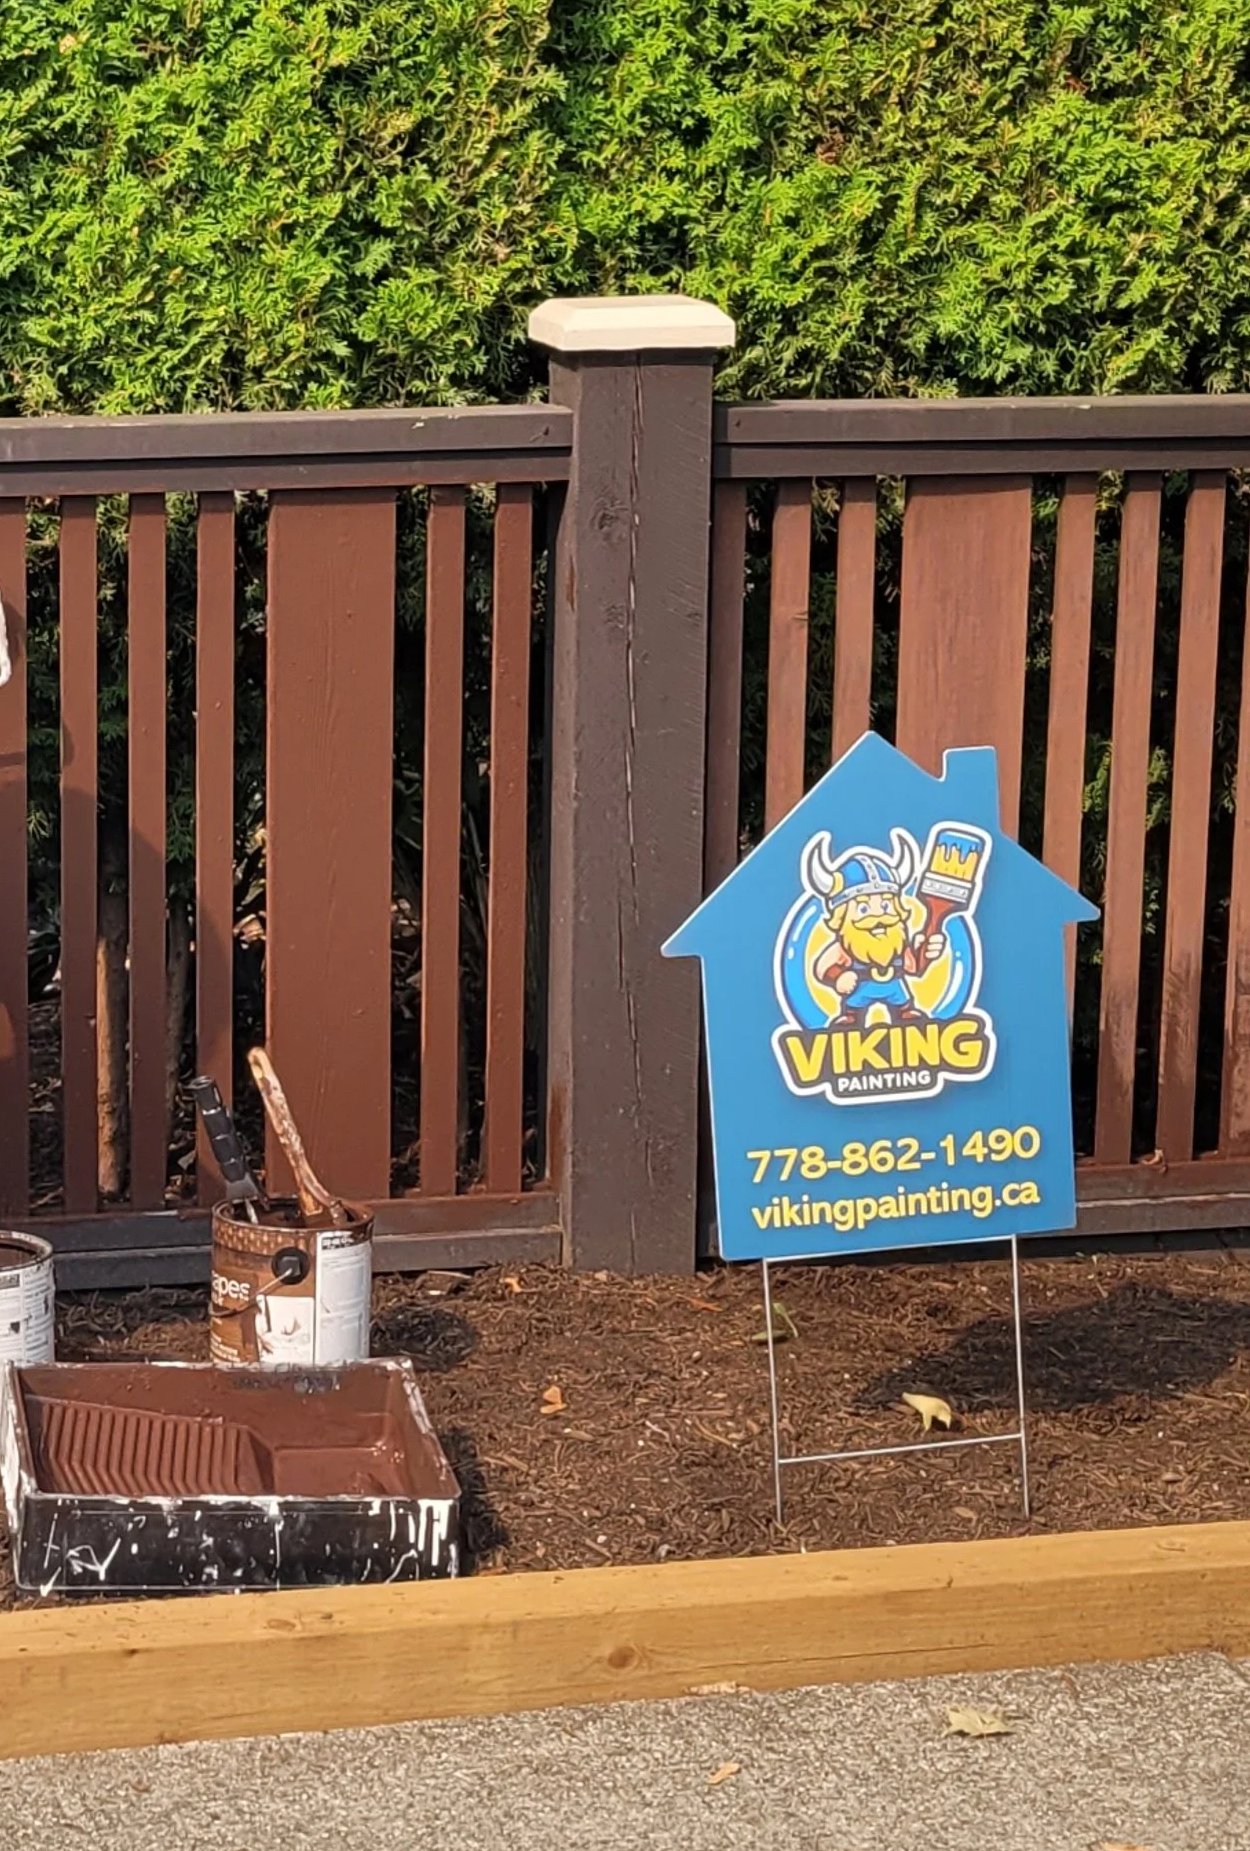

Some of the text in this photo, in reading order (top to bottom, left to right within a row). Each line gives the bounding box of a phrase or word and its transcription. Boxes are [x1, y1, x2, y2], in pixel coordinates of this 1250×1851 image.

[785, 1020, 983, 1083] VIKING
[837, 1070, 932, 1092] PAINTING
[746, 1125, 1041, 1184] 778-862-1490
[751, 1181, 1041, 1232] vikingpainting.ca
